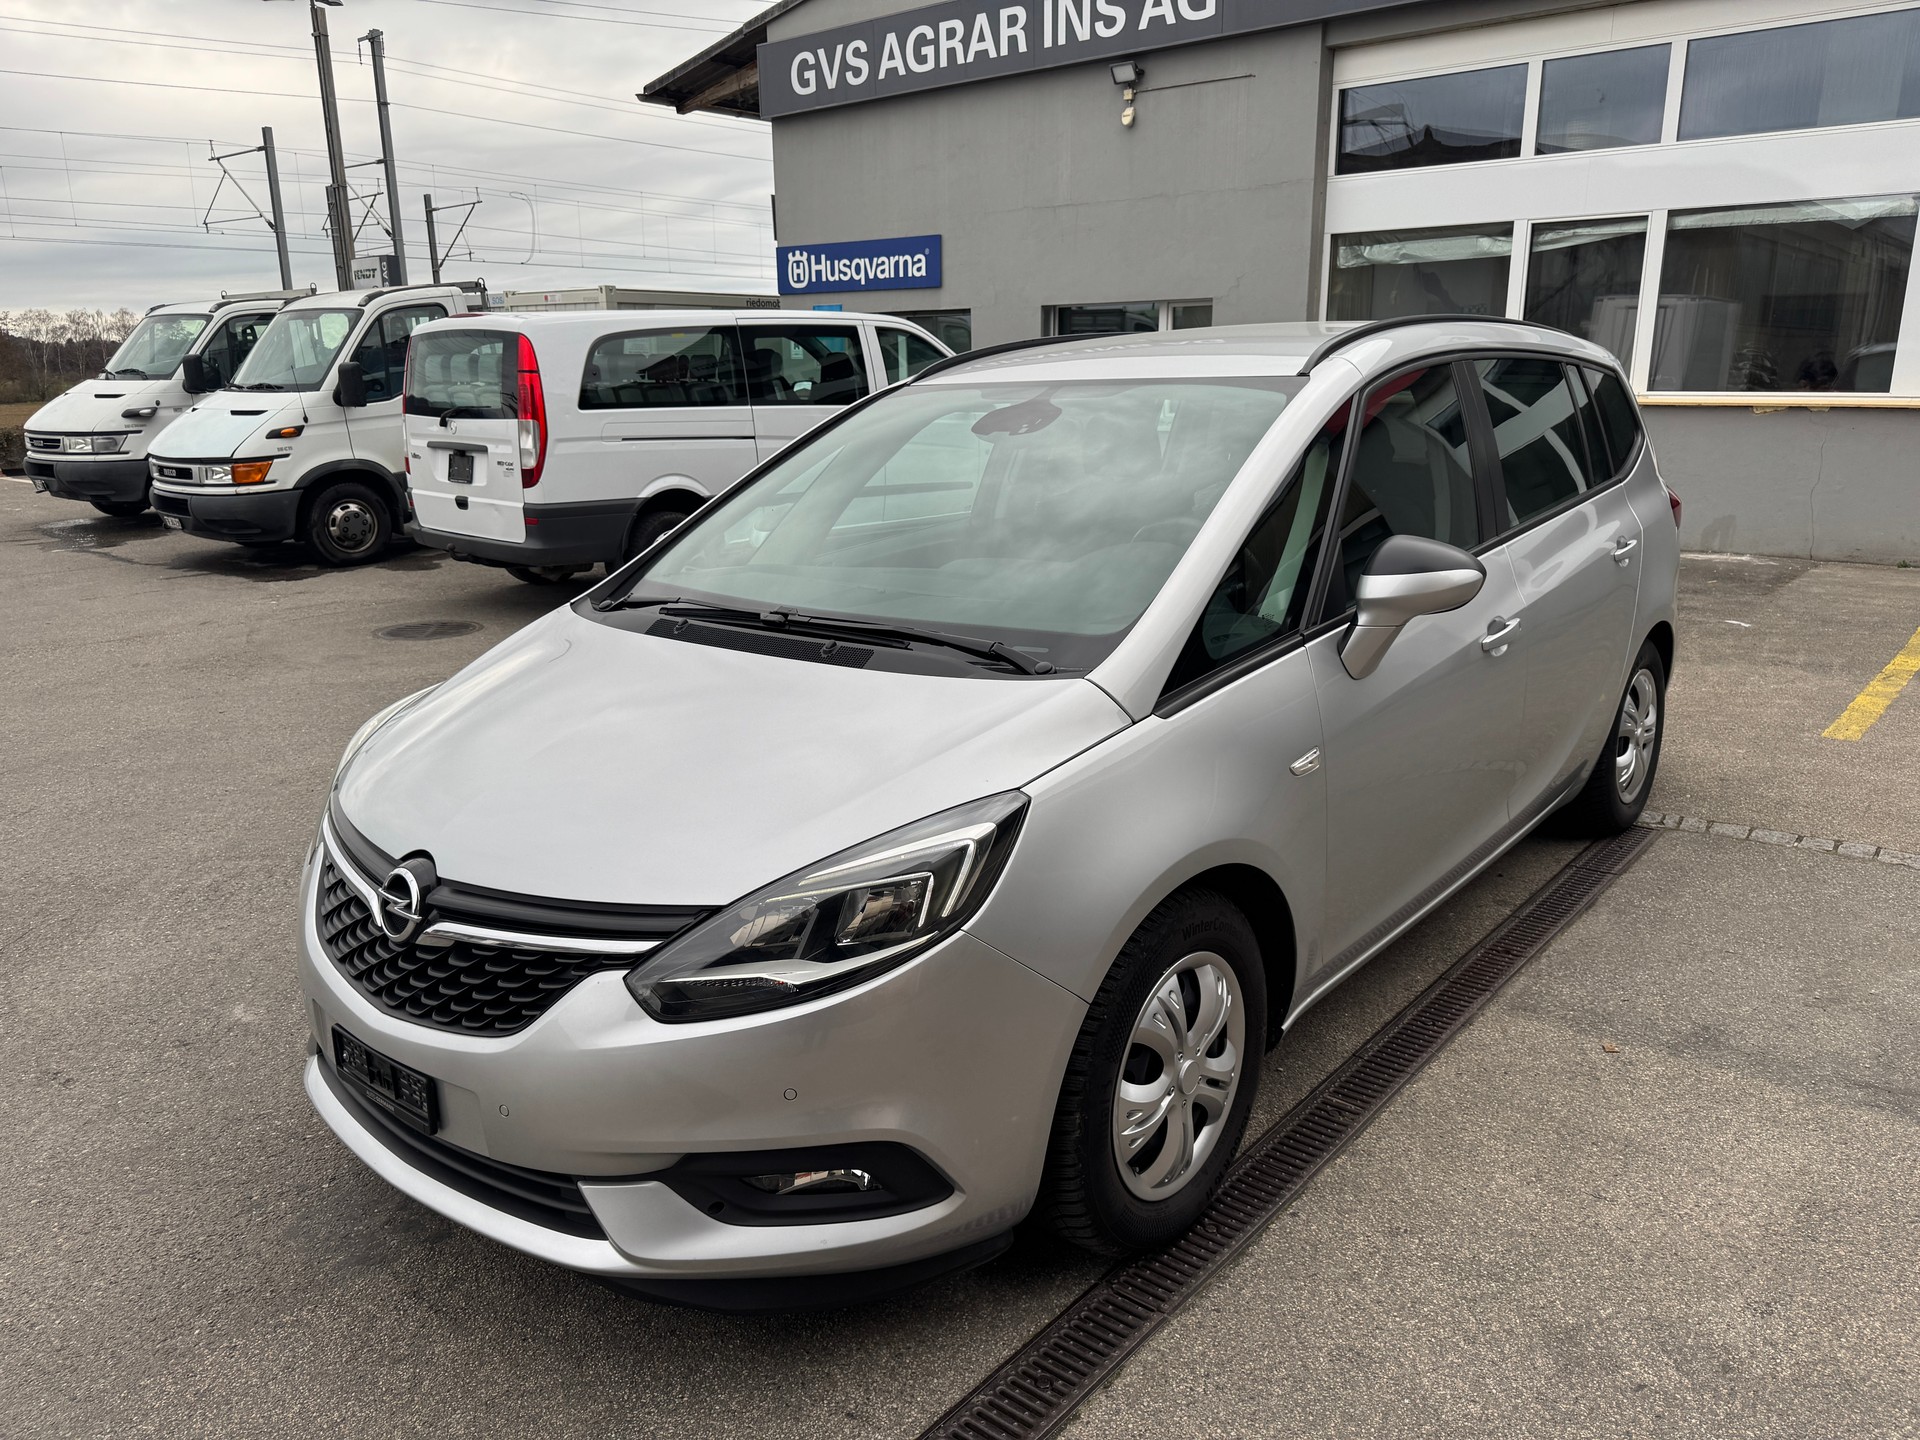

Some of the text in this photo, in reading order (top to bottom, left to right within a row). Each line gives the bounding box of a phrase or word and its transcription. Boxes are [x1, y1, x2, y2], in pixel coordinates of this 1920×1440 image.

[790, 39, 869, 96] GVS
[878, 5, 1027, 80] AGRAR
[1043, 0, 1126, 48] INS
[810, 253, 927, 285] Husqvarna
